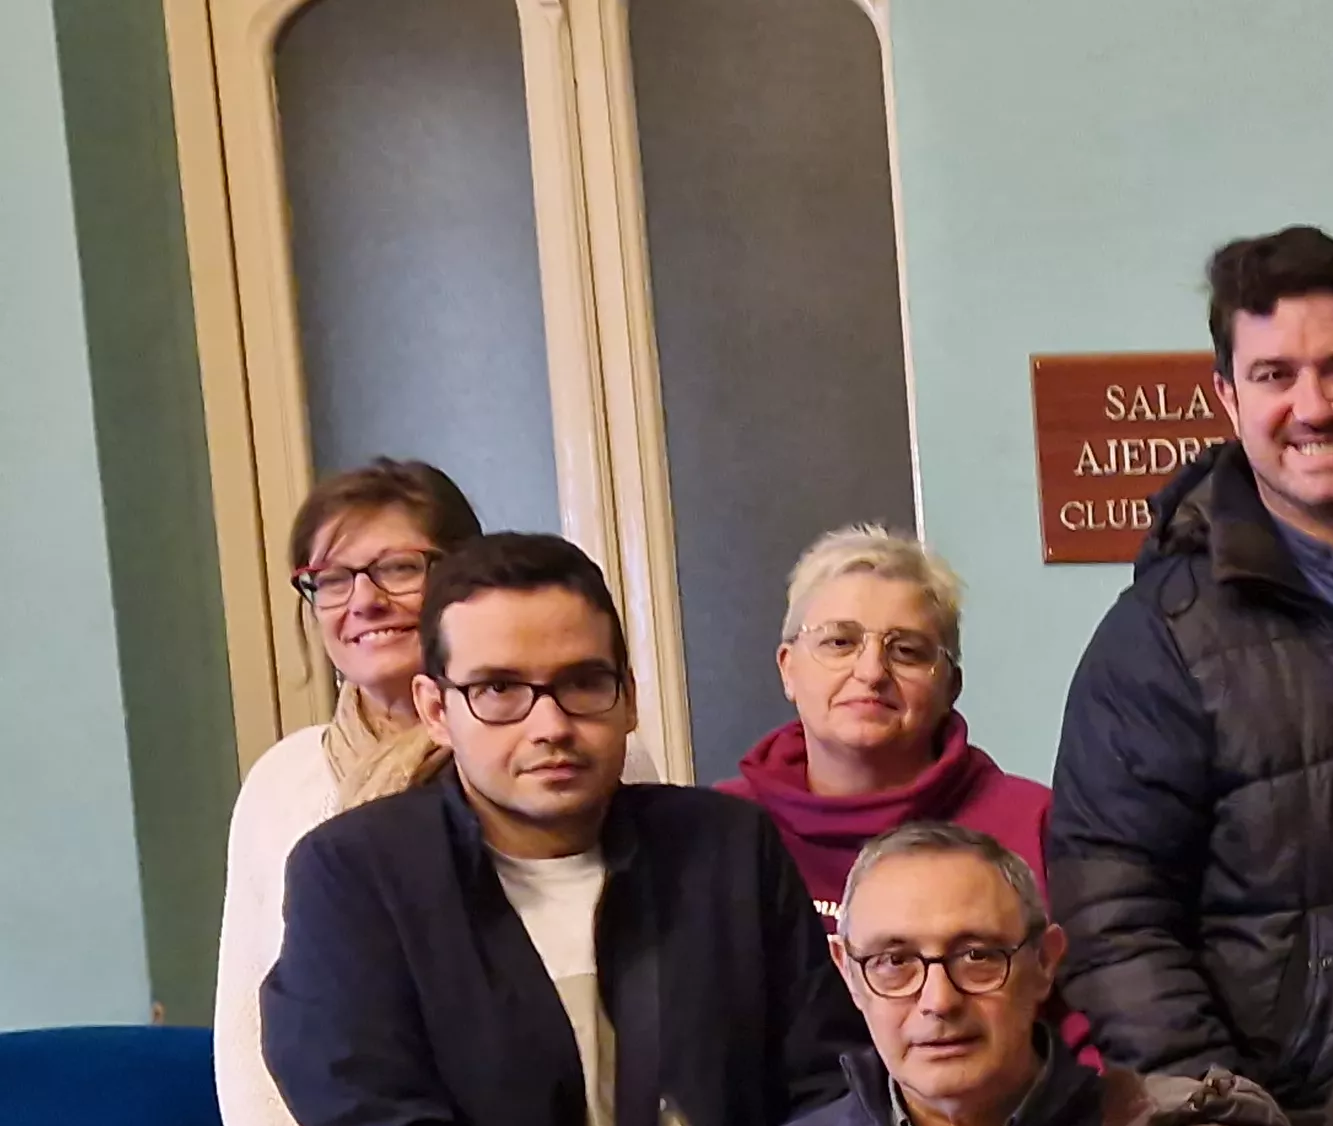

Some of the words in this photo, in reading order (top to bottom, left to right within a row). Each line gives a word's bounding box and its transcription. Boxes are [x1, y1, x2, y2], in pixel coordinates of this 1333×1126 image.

[1105, 383, 1215, 421] SALA
[1074, 436, 1227, 477] AJEDR
[1060, 498, 1153, 531] CLUB
